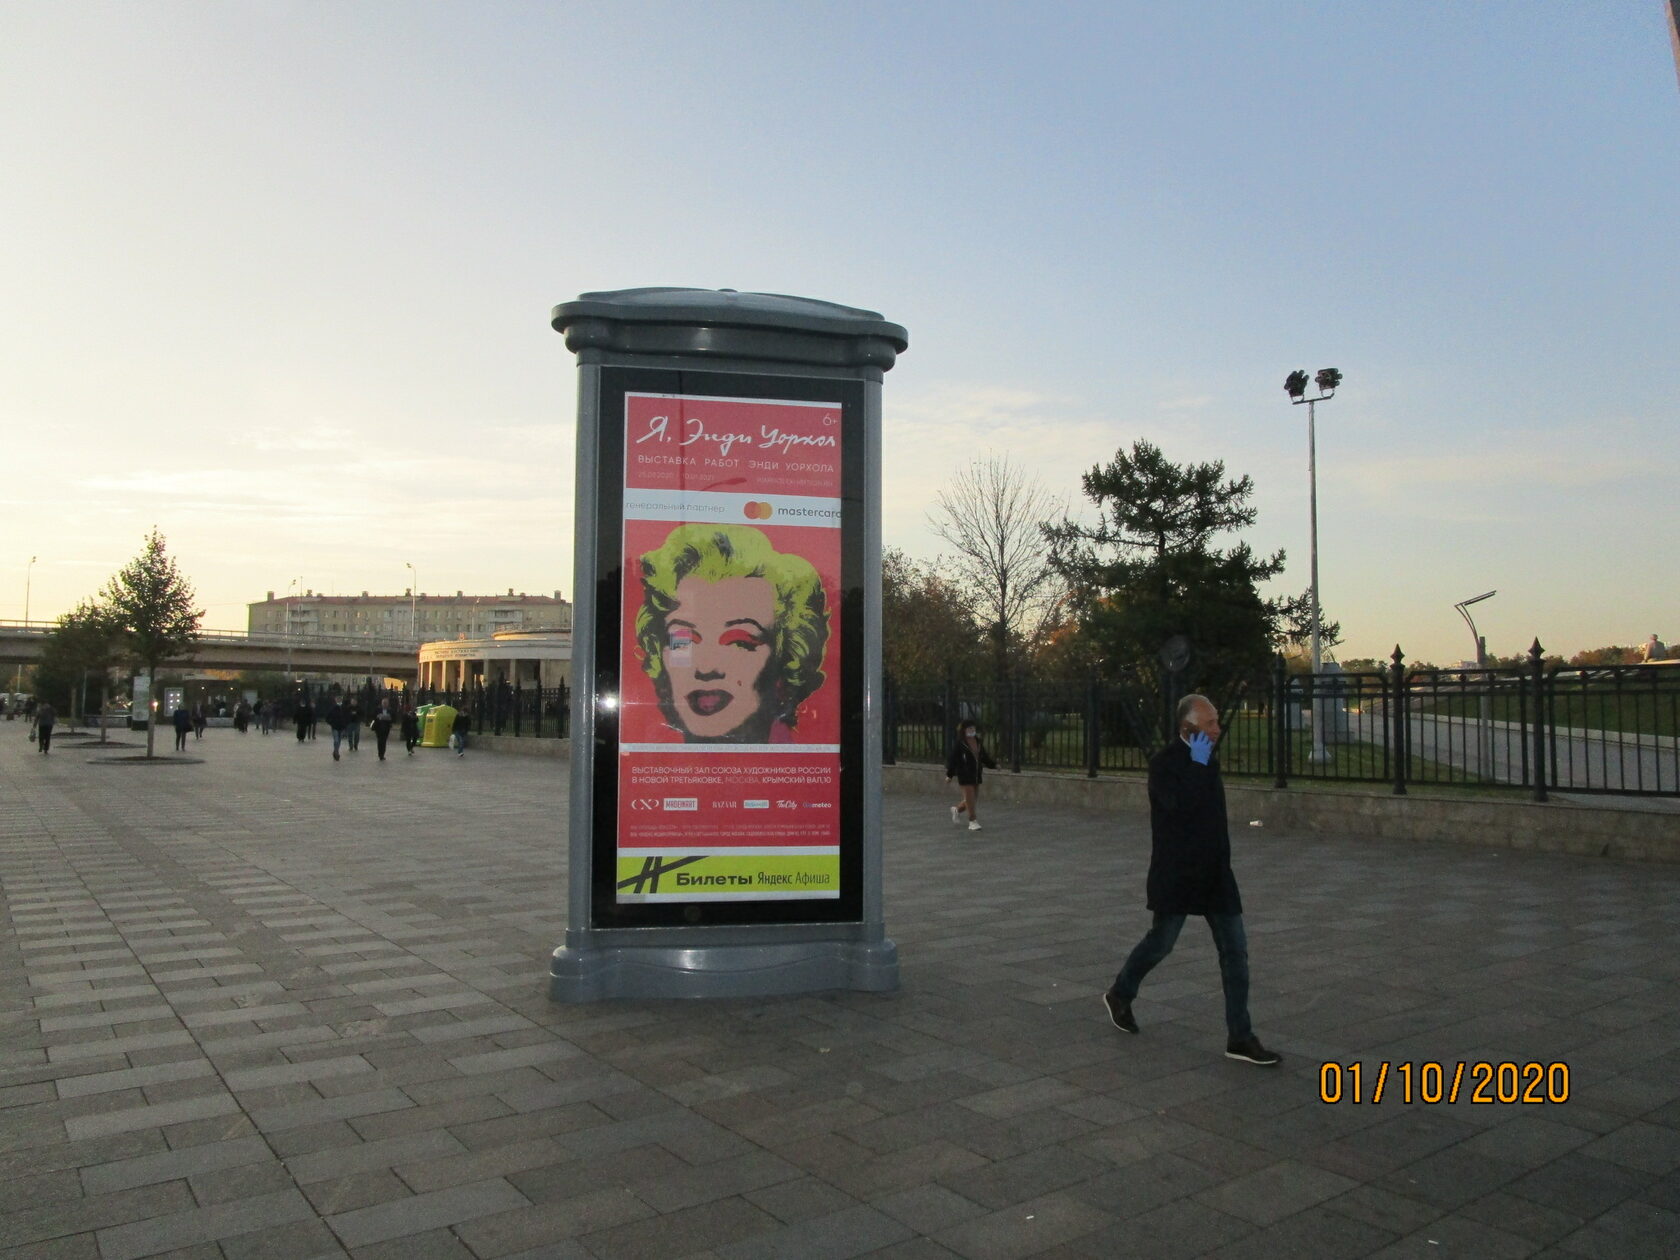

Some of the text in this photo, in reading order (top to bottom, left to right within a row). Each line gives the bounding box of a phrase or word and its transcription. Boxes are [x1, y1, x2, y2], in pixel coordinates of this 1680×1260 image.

[823, 412, 838, 426] 6+
[680, 418, 752, 457] Энди
[759, 424, 836, 455] Уорхол
[638, 454, 834, 473] ВЫСТАВКА РАБОТ ЭНДИ УОРХОЛА
[631, 766, 832, 775] ВЫСТАВОЧНЫЙ ЗАЛ СОЮЗА ХУДОЖНИКОВ РОССИИ
[631, 776, 638, 784] В
[638, 776, 669, 784] НОВОЙ
[762, 776, 806, 784] КРЫМСКИЙ
[676, 871, 830, 886] Билеты Яндекс Афиша
